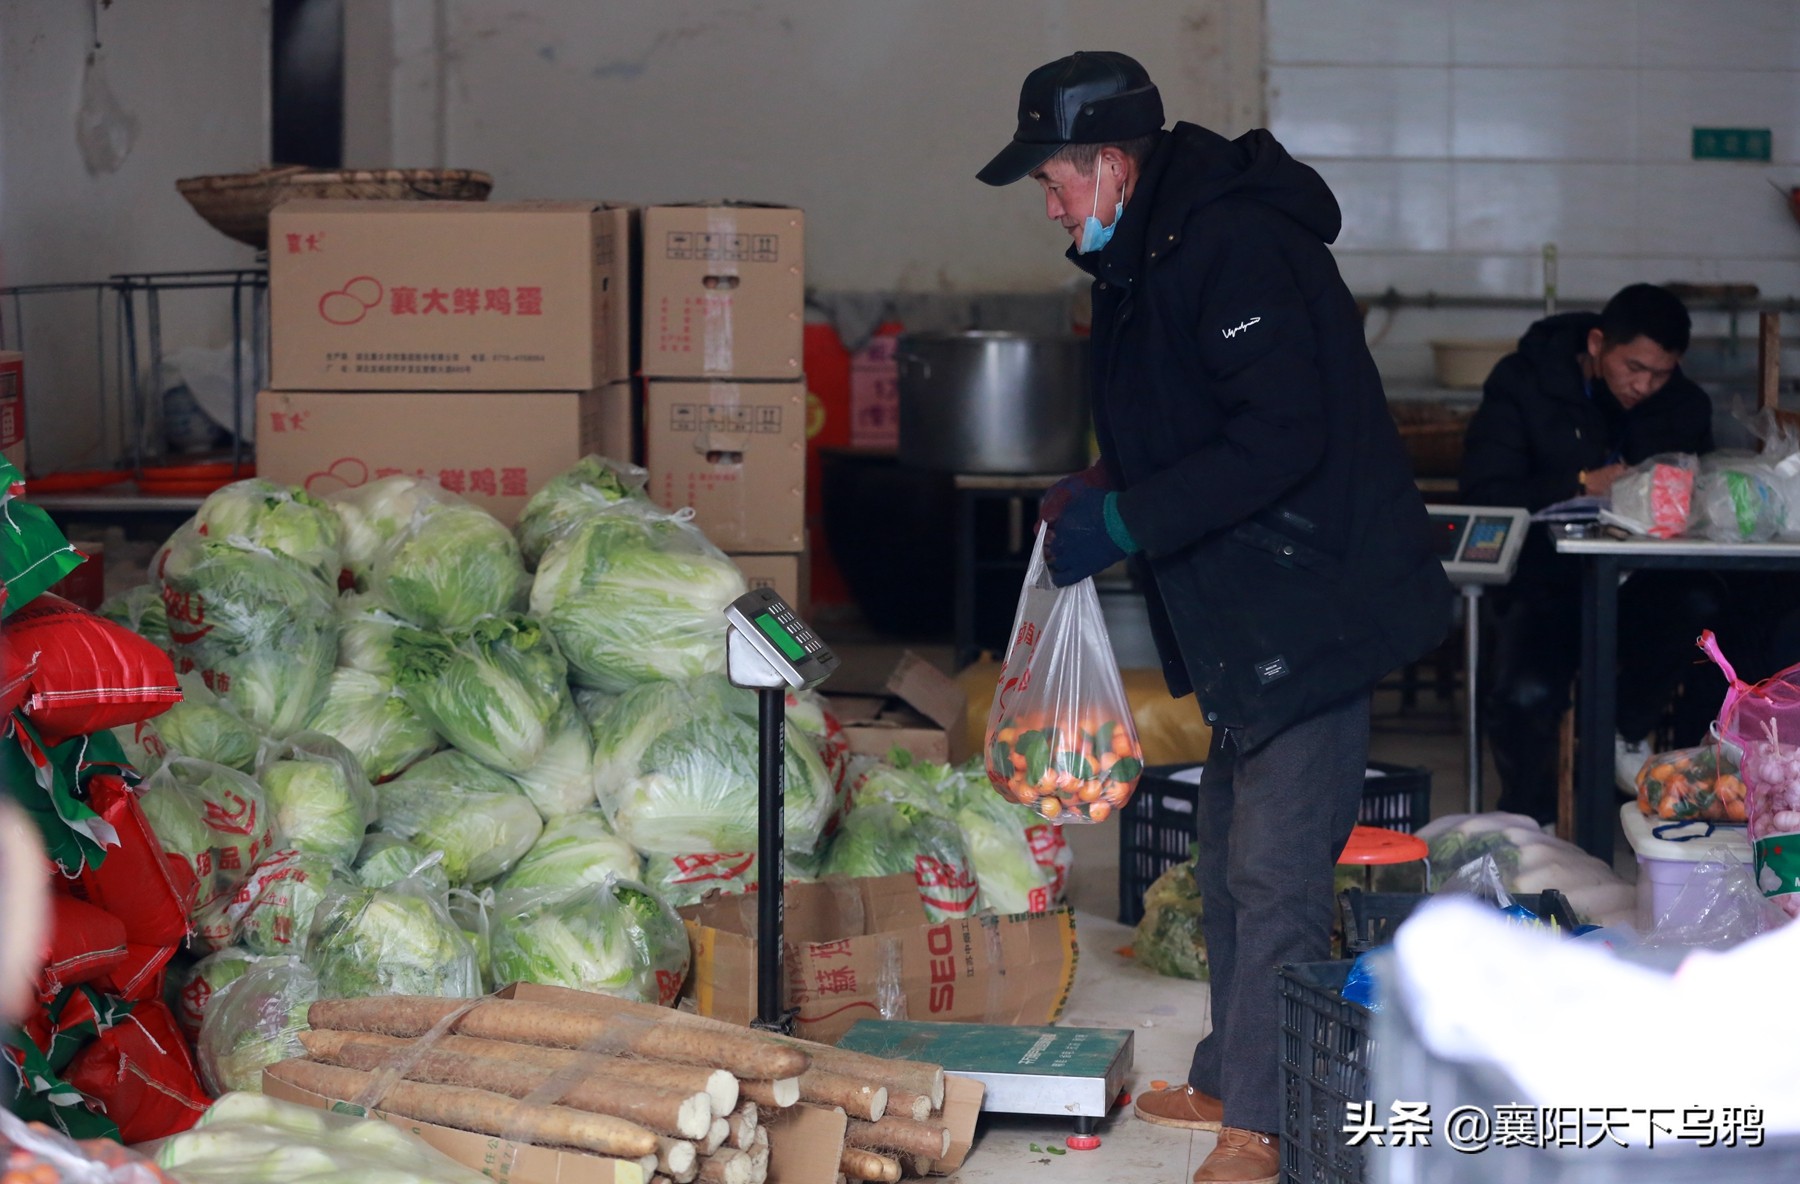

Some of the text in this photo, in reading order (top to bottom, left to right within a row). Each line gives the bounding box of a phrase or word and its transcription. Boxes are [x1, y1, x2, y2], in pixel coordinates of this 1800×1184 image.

[390, 286, 543, 316] 襄大鲜鸡蛋
[375, 467, 527, 497] 鲜鸡蛋
[961, 917, 975, 978] 江苏中烟工
